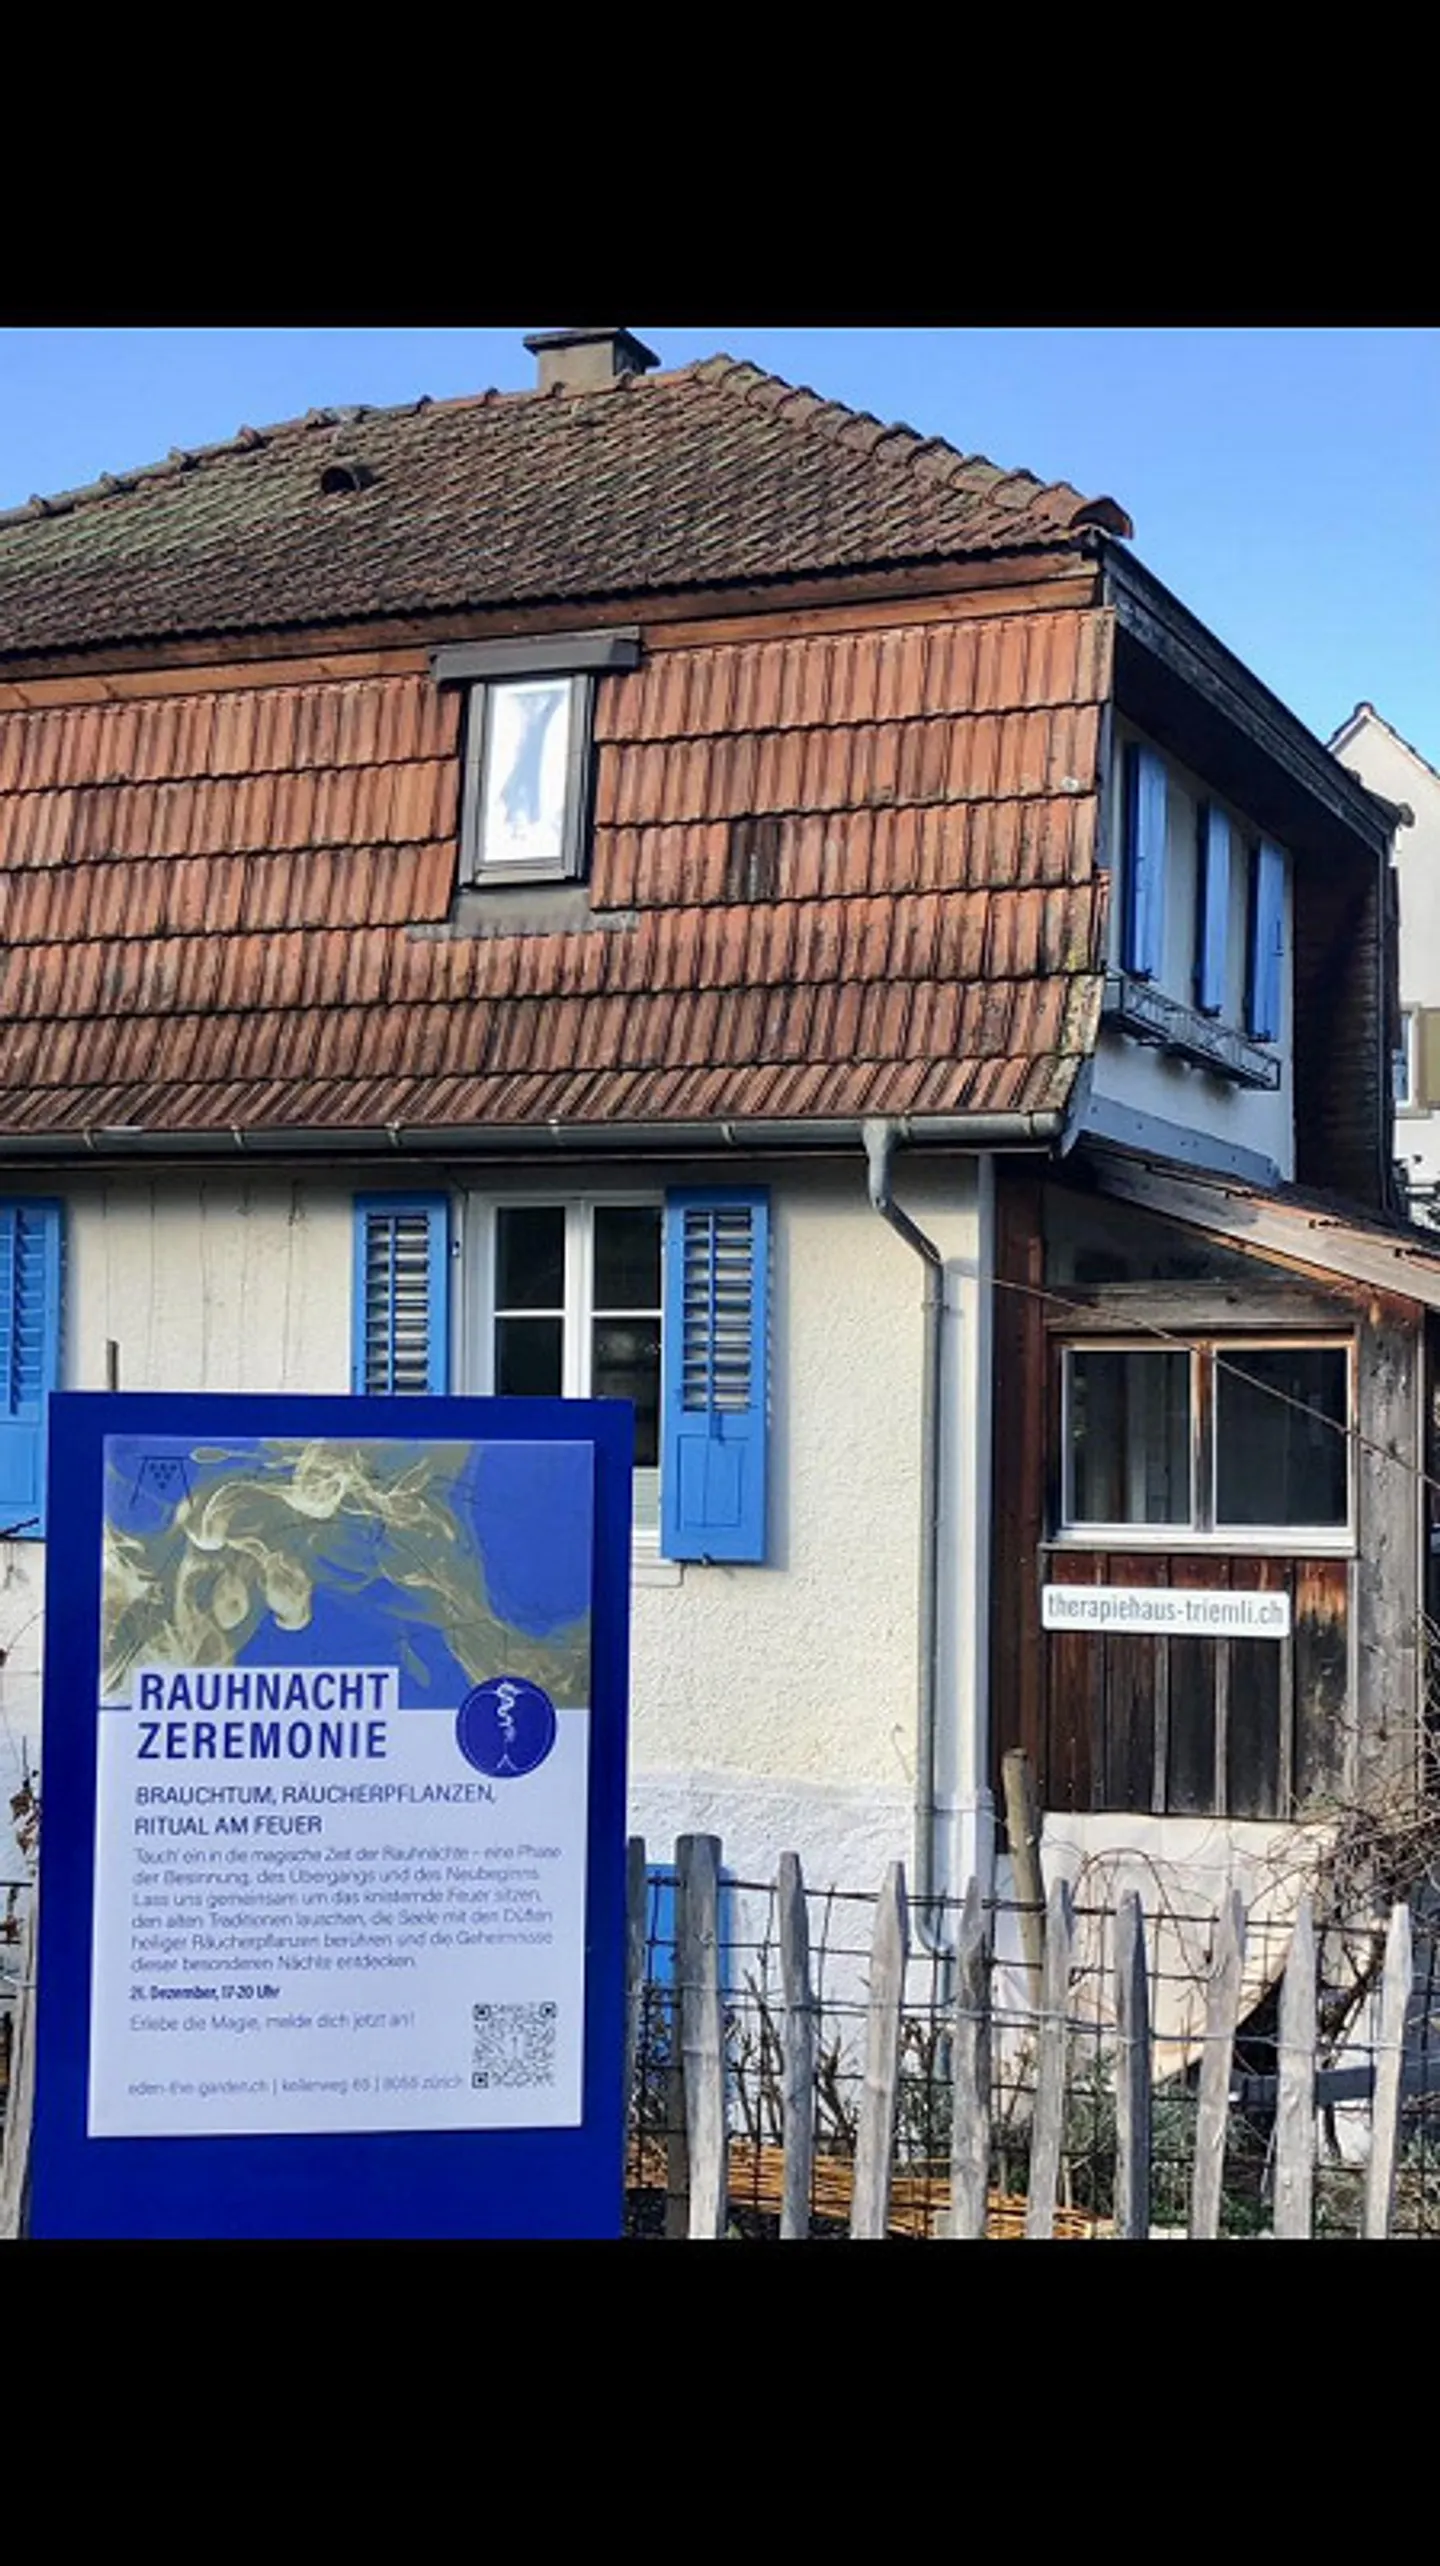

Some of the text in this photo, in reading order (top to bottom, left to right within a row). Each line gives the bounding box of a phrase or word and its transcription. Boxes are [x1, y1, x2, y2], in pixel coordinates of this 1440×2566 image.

[1048, 1594, 1284, 1625] therapiehaus-triemli.ch
[140, 1673, 390, 1710] RAUHNACHT
[136, 1722, 388, 1759] ZEREMONIE
[135, 1781, 496, 1805] BRAUCHTUM, RÄUCHERPFLANZEN,
[134, 1815, 322, 1835] RITUAL AM FEUER
[183, 1848, 205, 1864] ein
[208, 1848, 222, 1863] in
[224, 1848, 248, 1864] die
[252, 1848, 321, 1866] magische
[324, 1848, 351, 1862] Zeit
[355, 1847, 378, 1861] der
[382, 1846, 469, 1861] Rauhnächte
[484, 1846, 514, 1860] eine
[518, 1845, 562, 1860] Phase
[132, 1870, 159, 1884] der
[163, 1870, 251, 1887] Besinnung,
[256, 1869, 285, 1884] des
[289, 1867, 376, 1887] Übergangs
[379, 1867, 410, 1883] und
[414, 1867, 442, 1881] des
[133, 1893, 168, 1907] Lass
[173, 1895, 203, 1907] uns
[206, 1892, 296, 1909] gemeinsam
[301, 1893, 329, 1905] um
[331, 1891, 360, 1905] das
[364, 1889, 443, 1904] knisternde
[447, 1888, 490, 1903] Feuer
[131, 1907, 553, 1929] den alten Traditionen lauschen, die Seele mit den Düften
[131, 1929, 553, 1953] heiliger Räucherpflanzen berühren und die Geheimnisse
[130, 1957, 178, 1973] dieser
[182, 1955, 274, 1971] besonderen
[277, 1954, 332, 1970] Nächte
[151, 1984, 219, 2002] Dezember,
[256, 1983, 280, 2000] Uhr
[131, 2011, 416, 2033] Erlebe die Magie, melde dich jetzt an!
